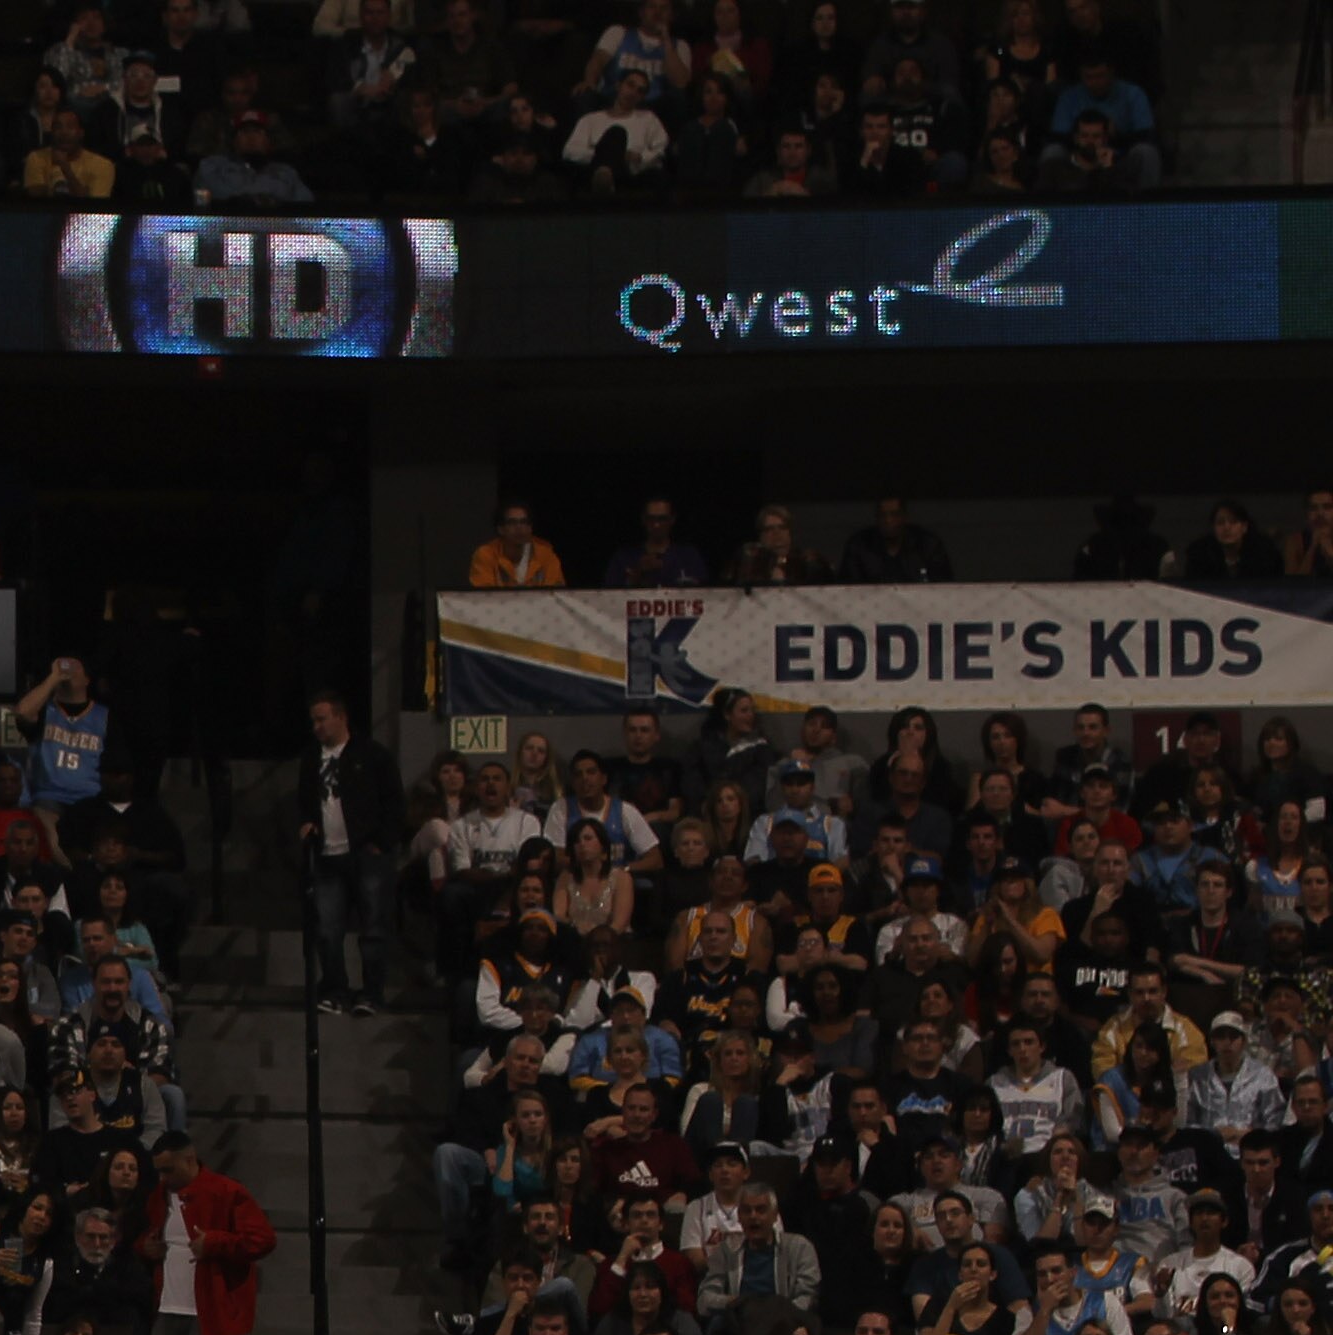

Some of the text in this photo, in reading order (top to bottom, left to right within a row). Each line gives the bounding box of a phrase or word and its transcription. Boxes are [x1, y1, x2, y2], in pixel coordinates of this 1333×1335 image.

[162, 231, 352, 340] HD
[617, 274, 906, 352] Qwest
[626, 600, 704, 617] EDDIE'S
[775, 618, 1263, 682] EDDIE'S KIDS
[44, 726, 103, 752] DENVER
[453, 717, 504, 751] EXIT
[56, 749, 80, 771] 15
